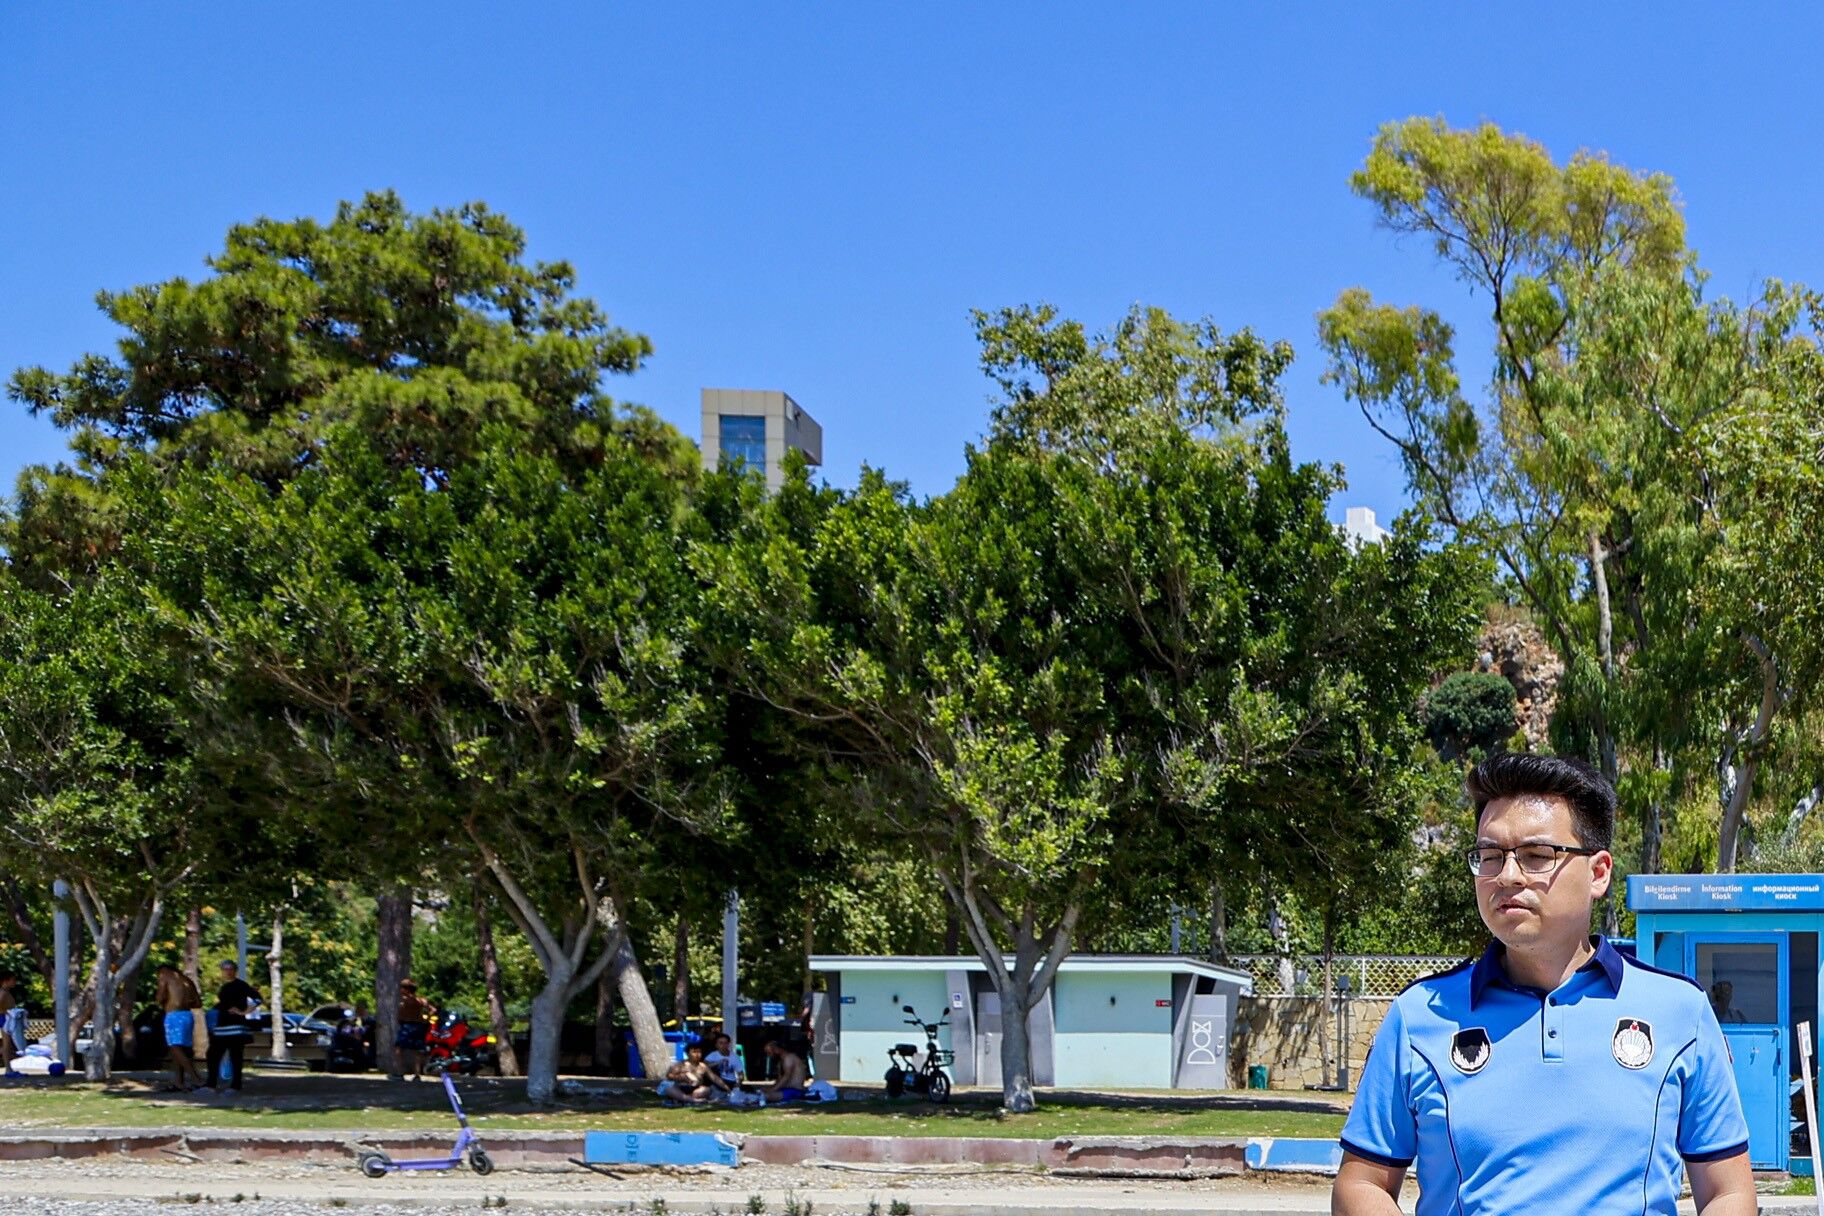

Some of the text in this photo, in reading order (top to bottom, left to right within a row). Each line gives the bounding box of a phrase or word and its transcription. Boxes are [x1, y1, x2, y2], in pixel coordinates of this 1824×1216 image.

[1644, 885, 1691, 894] Bilgilendirme
[1752, 884, 1820, 894] информационный
[1711, 892, 1732, 900] Kiosk
